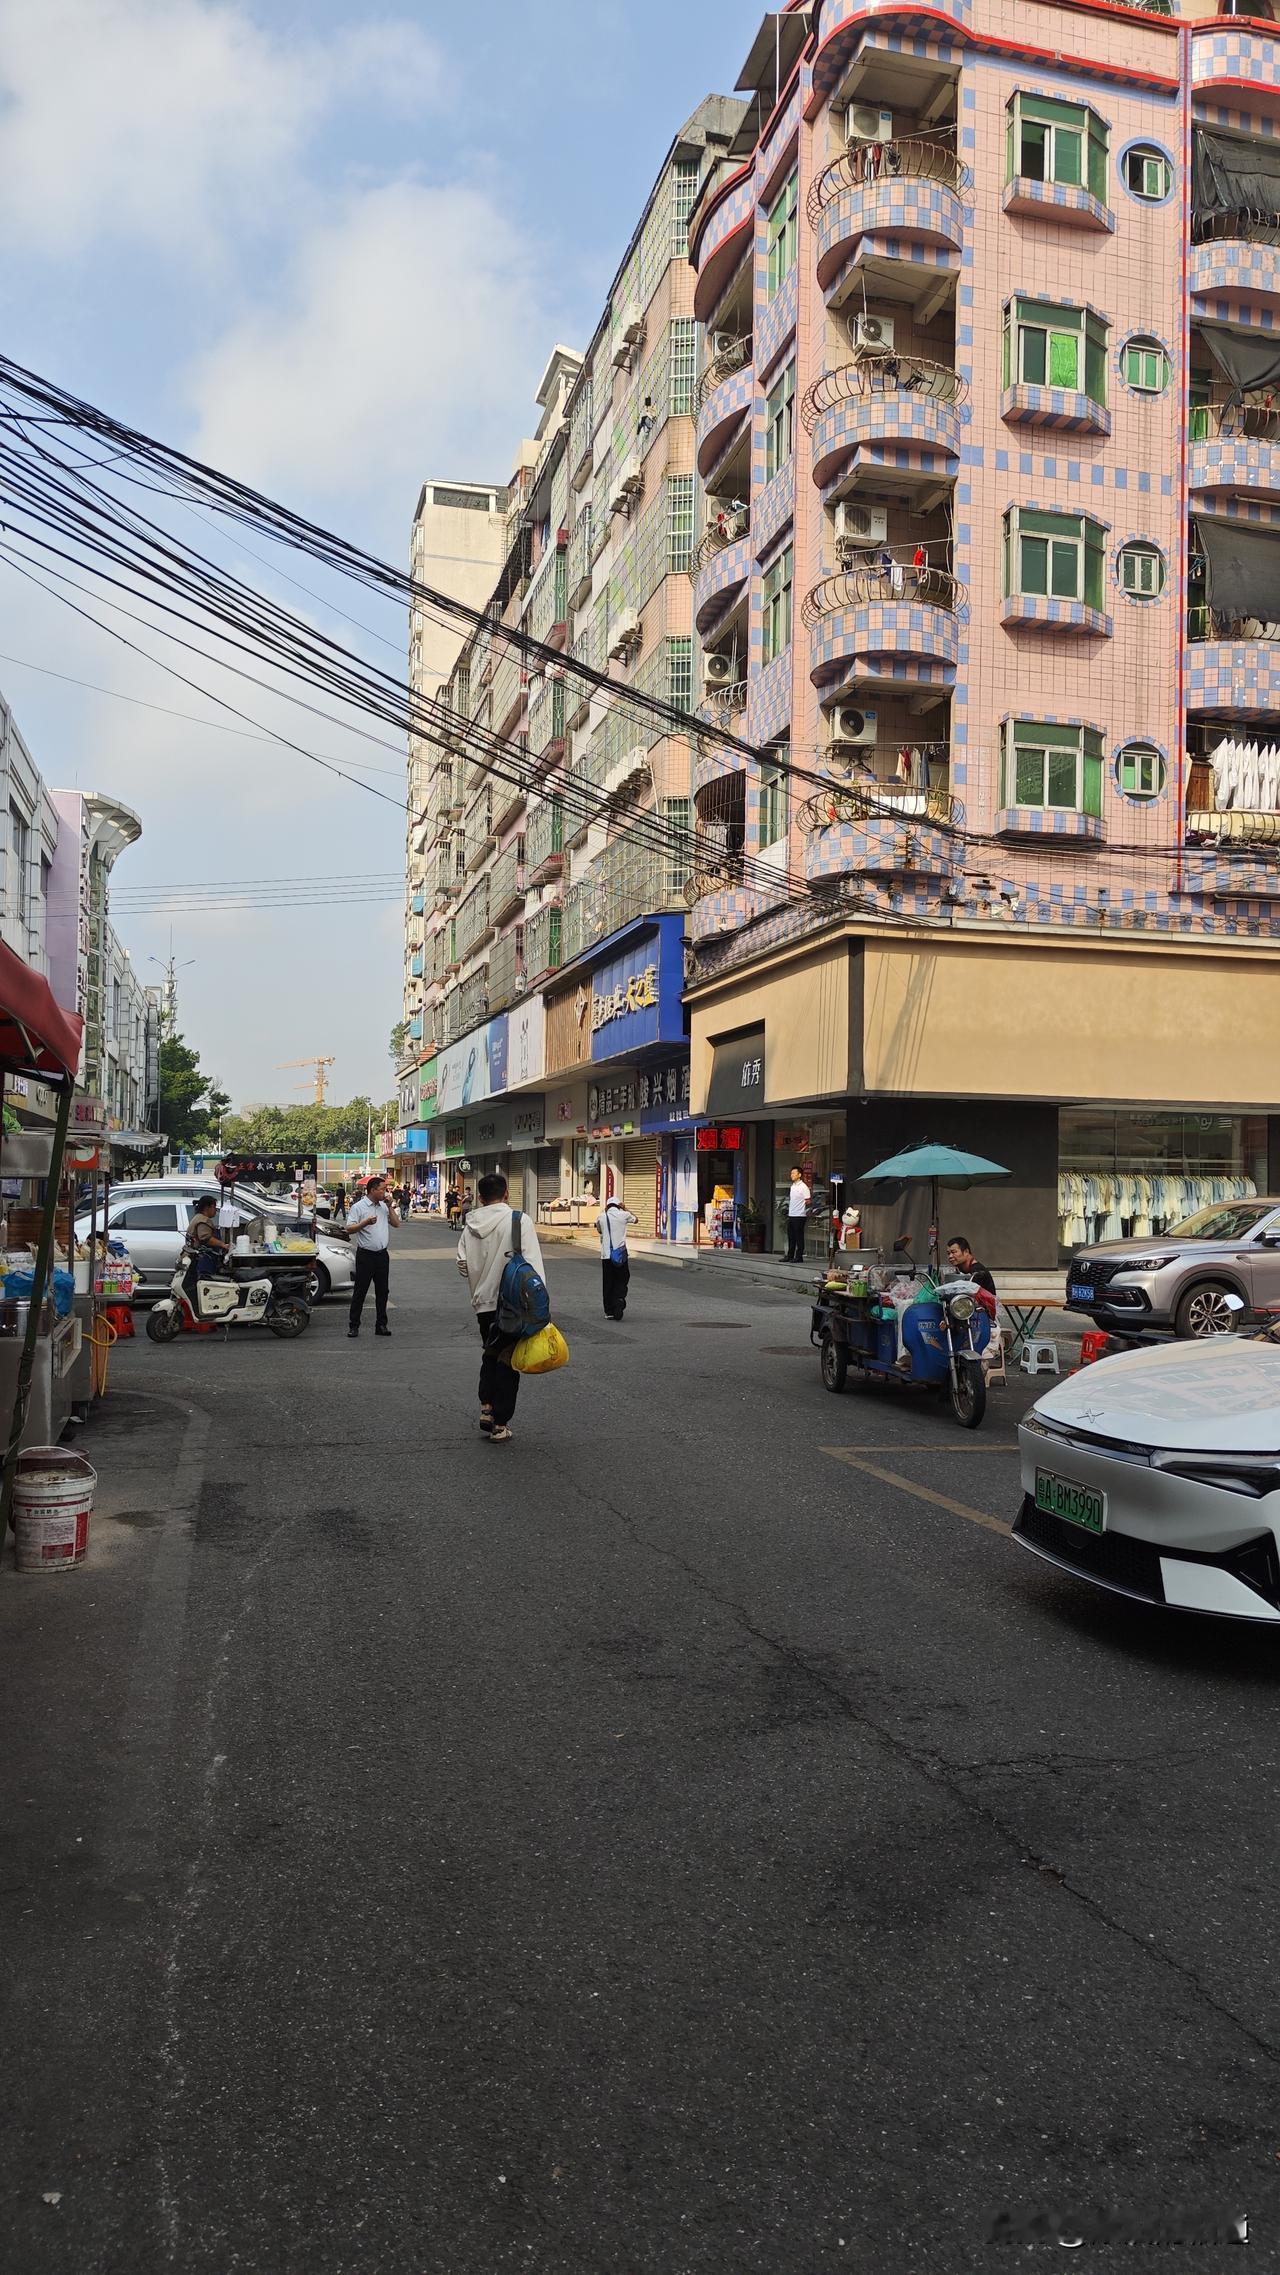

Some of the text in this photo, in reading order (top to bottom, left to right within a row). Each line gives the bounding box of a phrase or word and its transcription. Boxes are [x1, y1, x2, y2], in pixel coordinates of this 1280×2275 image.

[599, 1082, 636, 1116] 精品二手机
[238, 1161, 312, 1172] 正宗武汉热干面
